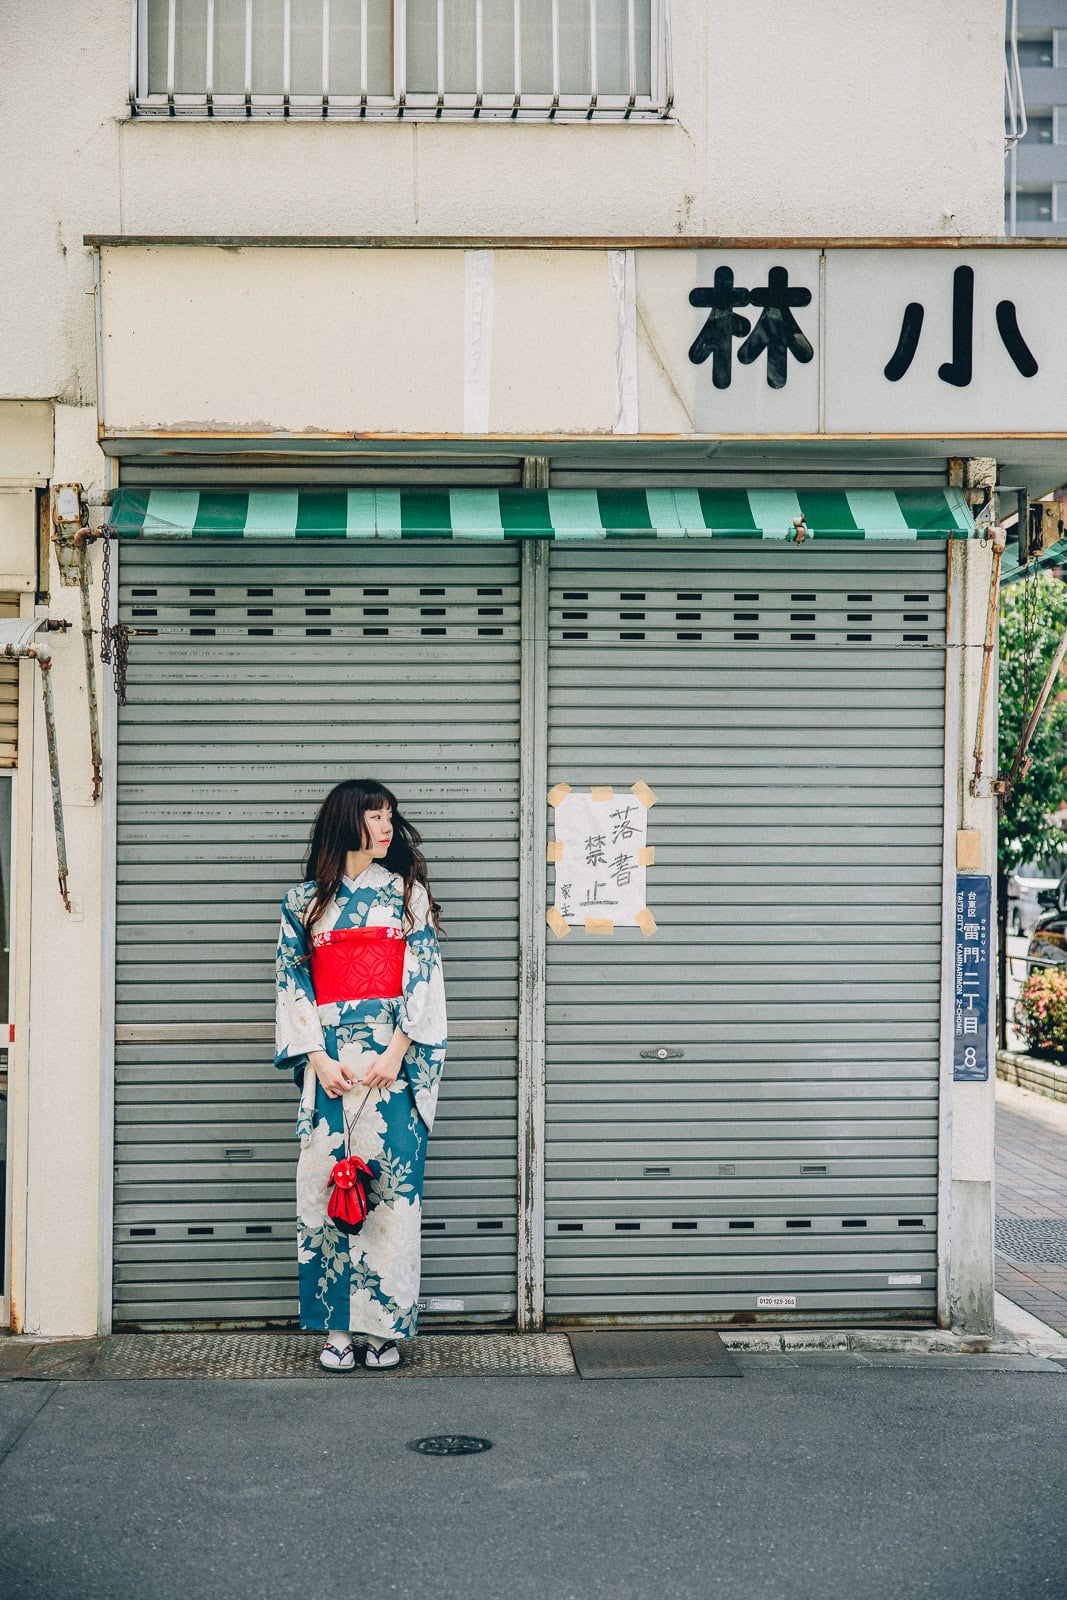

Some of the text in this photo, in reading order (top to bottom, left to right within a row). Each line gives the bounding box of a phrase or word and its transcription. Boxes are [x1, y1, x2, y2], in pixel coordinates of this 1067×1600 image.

[579, 835, 619, 907] 禁止
[608, 806, 643, 888] 落書
[967, 890, 977, 918] 台東区
[955, 890, 964, 1035] TAITO CITY KAMINARIMON 2-CHOME
[964, 1046, 977, 1068] 8
